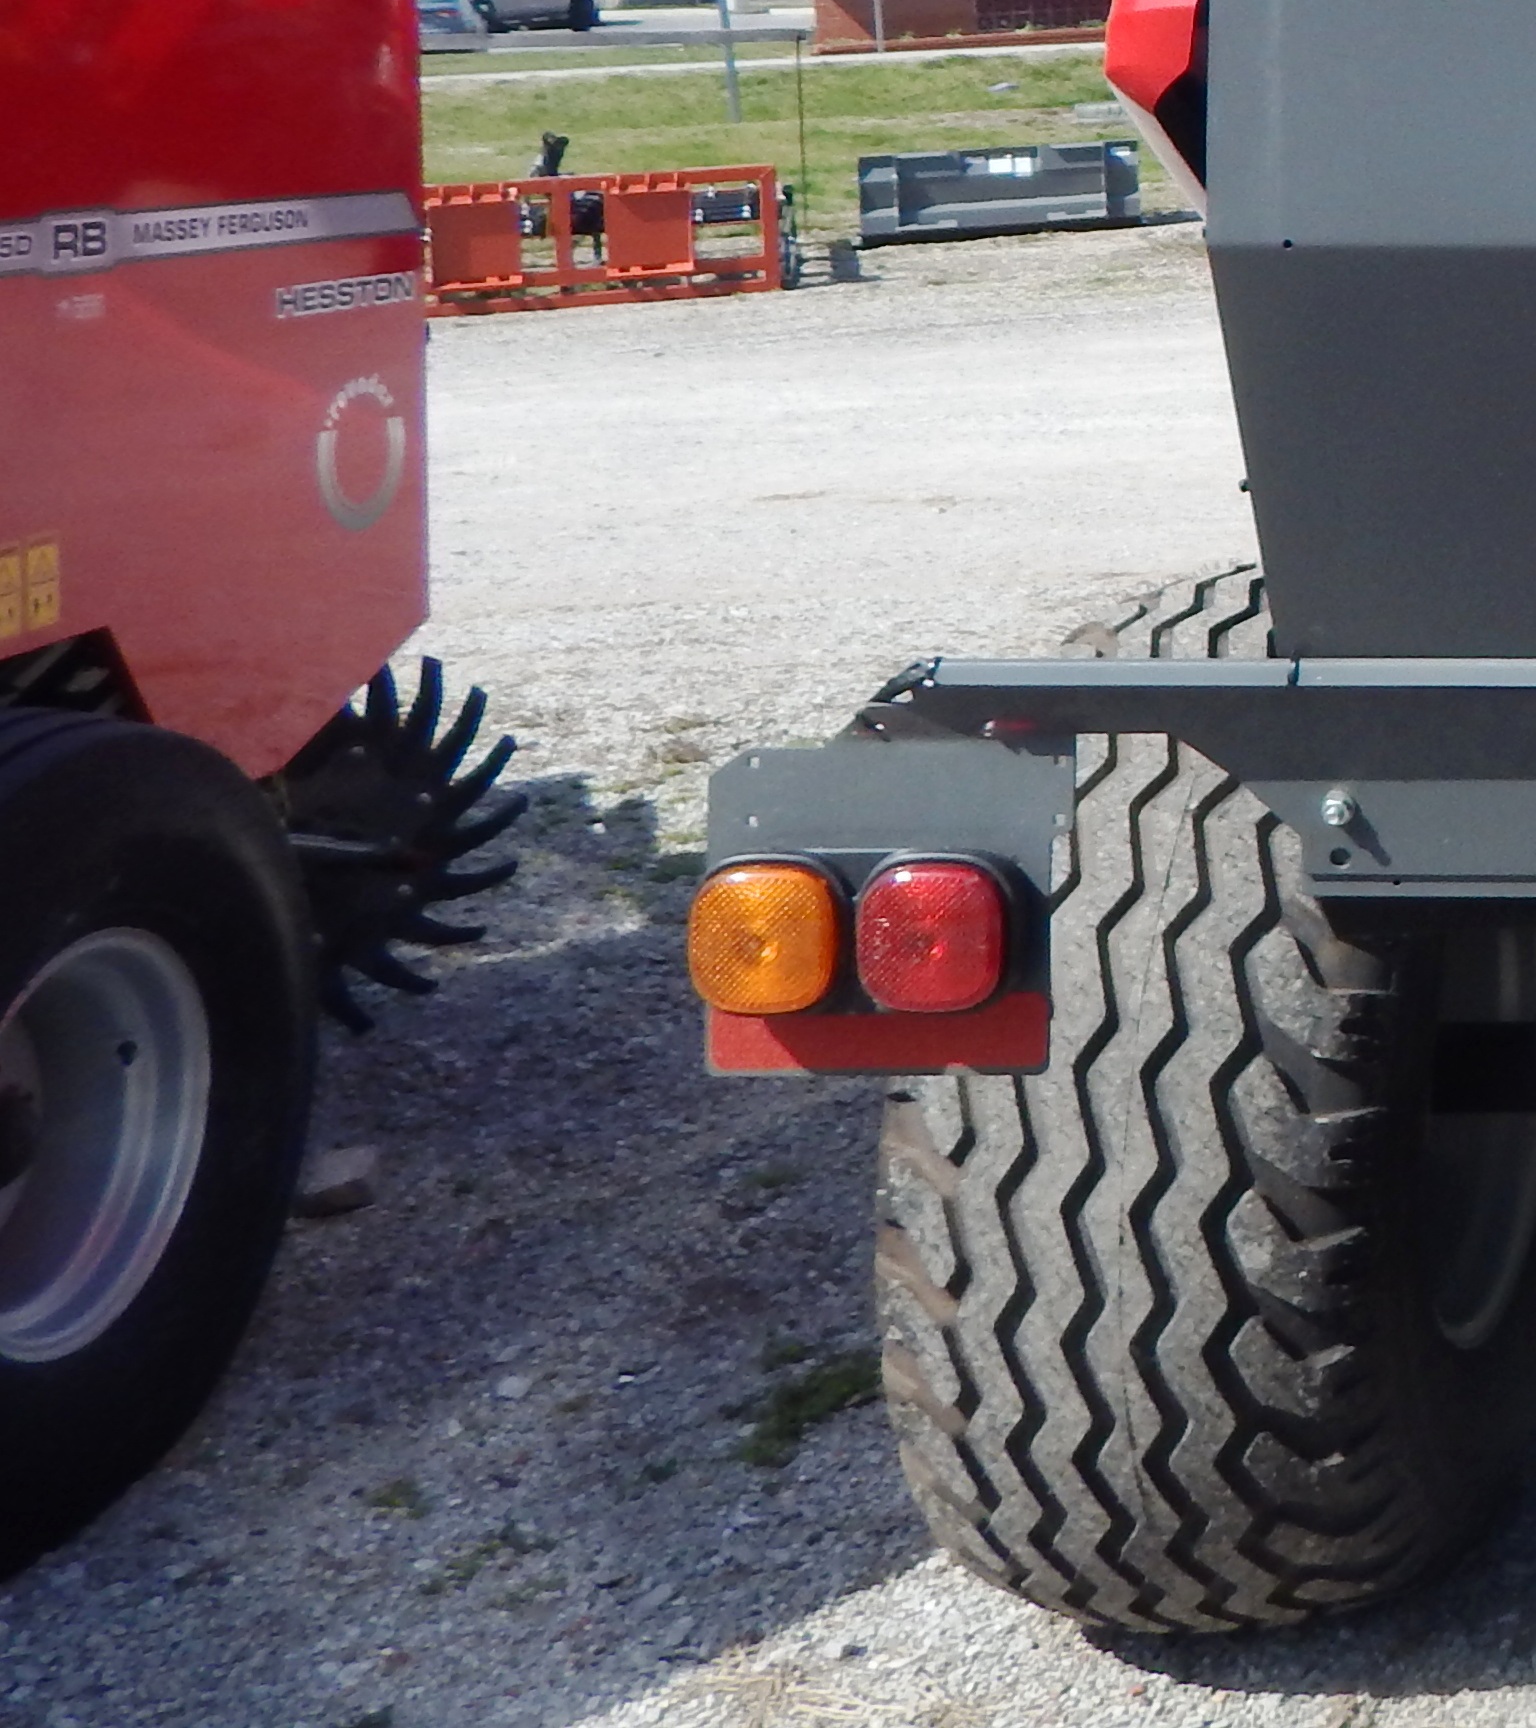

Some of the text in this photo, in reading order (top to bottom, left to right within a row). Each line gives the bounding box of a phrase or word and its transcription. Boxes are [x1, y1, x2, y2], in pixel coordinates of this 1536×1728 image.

[53, 221, 106, 259] RB
[133, 209, 309, 244] MASSEY FERGUSON
[277, 272, 415, 318] HESSTON
